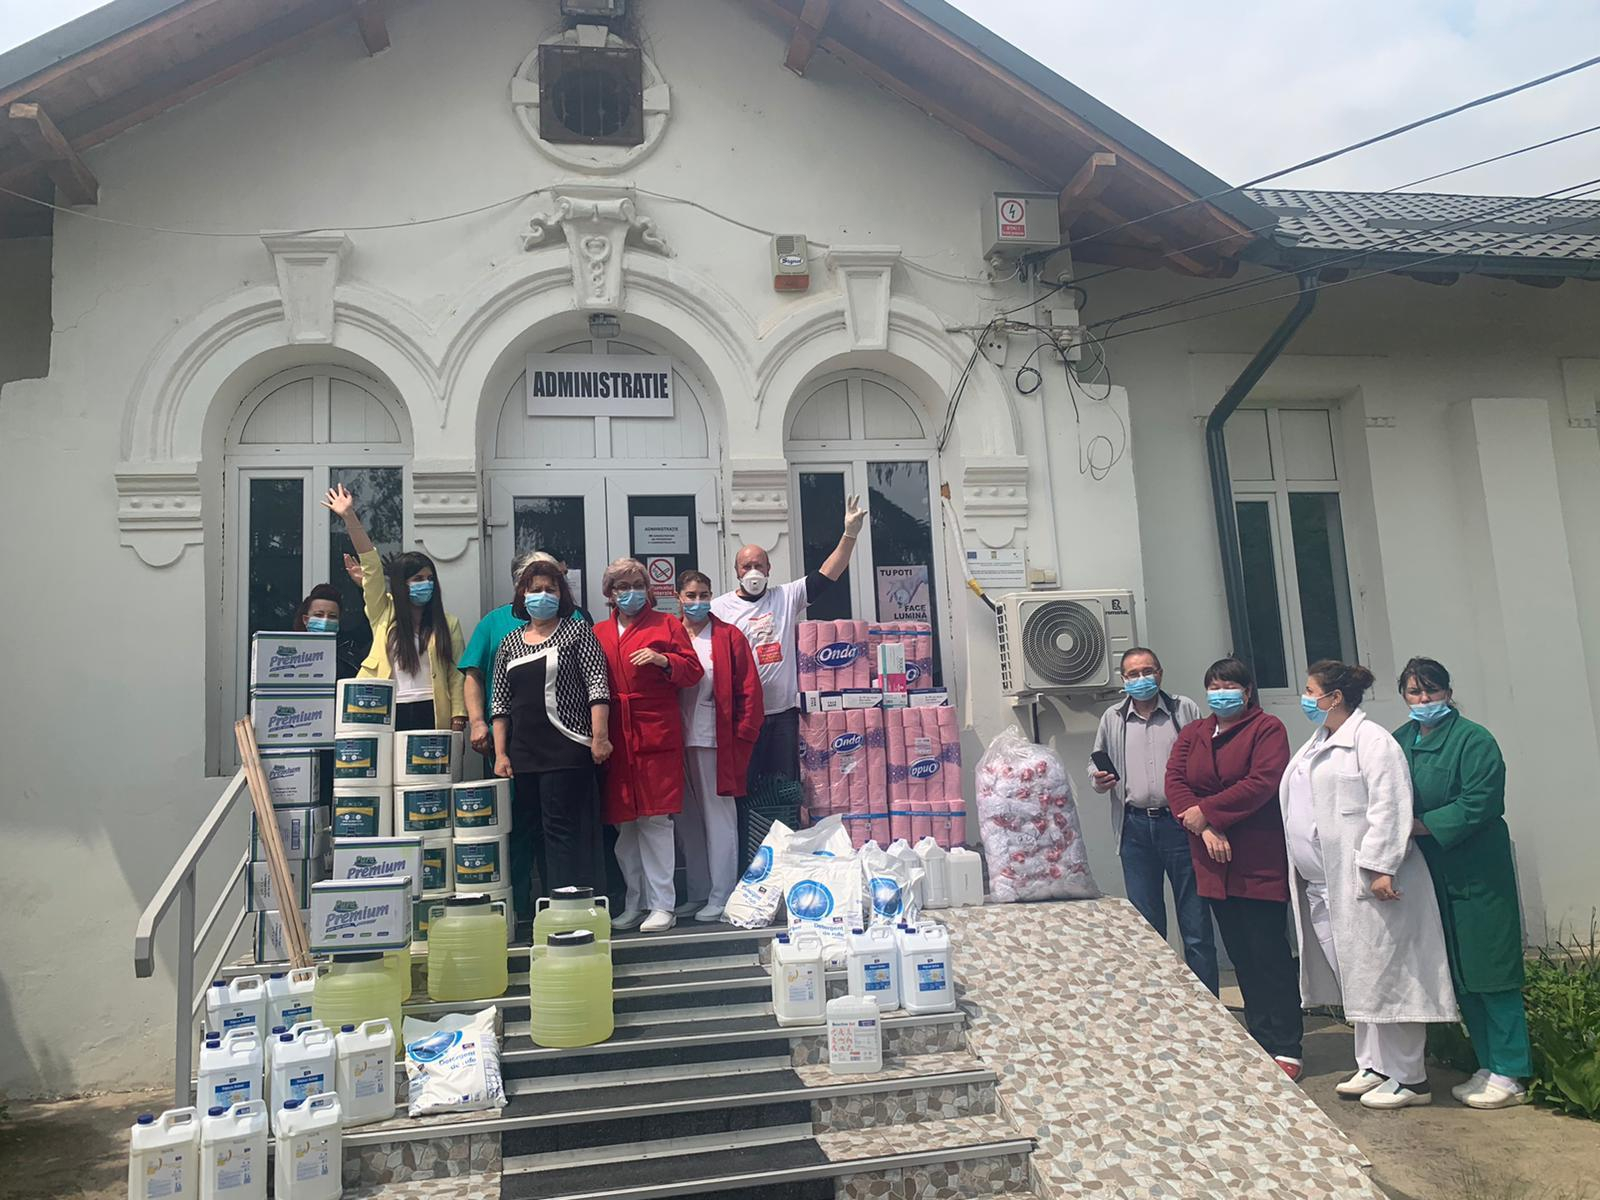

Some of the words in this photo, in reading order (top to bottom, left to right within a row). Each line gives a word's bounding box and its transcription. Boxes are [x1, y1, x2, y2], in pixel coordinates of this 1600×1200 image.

[533, 371, 669, 399] ADMINISTRATIE
[269, 652, 324, 667] Premium
[820, 645, 857, 661] Onda
[268, 710, 323, 728] Premium
[834, 735, 861, 748] Onda
[911, 762, 938, 776] Onda
[347, 860, 406, 879] Premium
[325, 904, 389, 927] Premium
